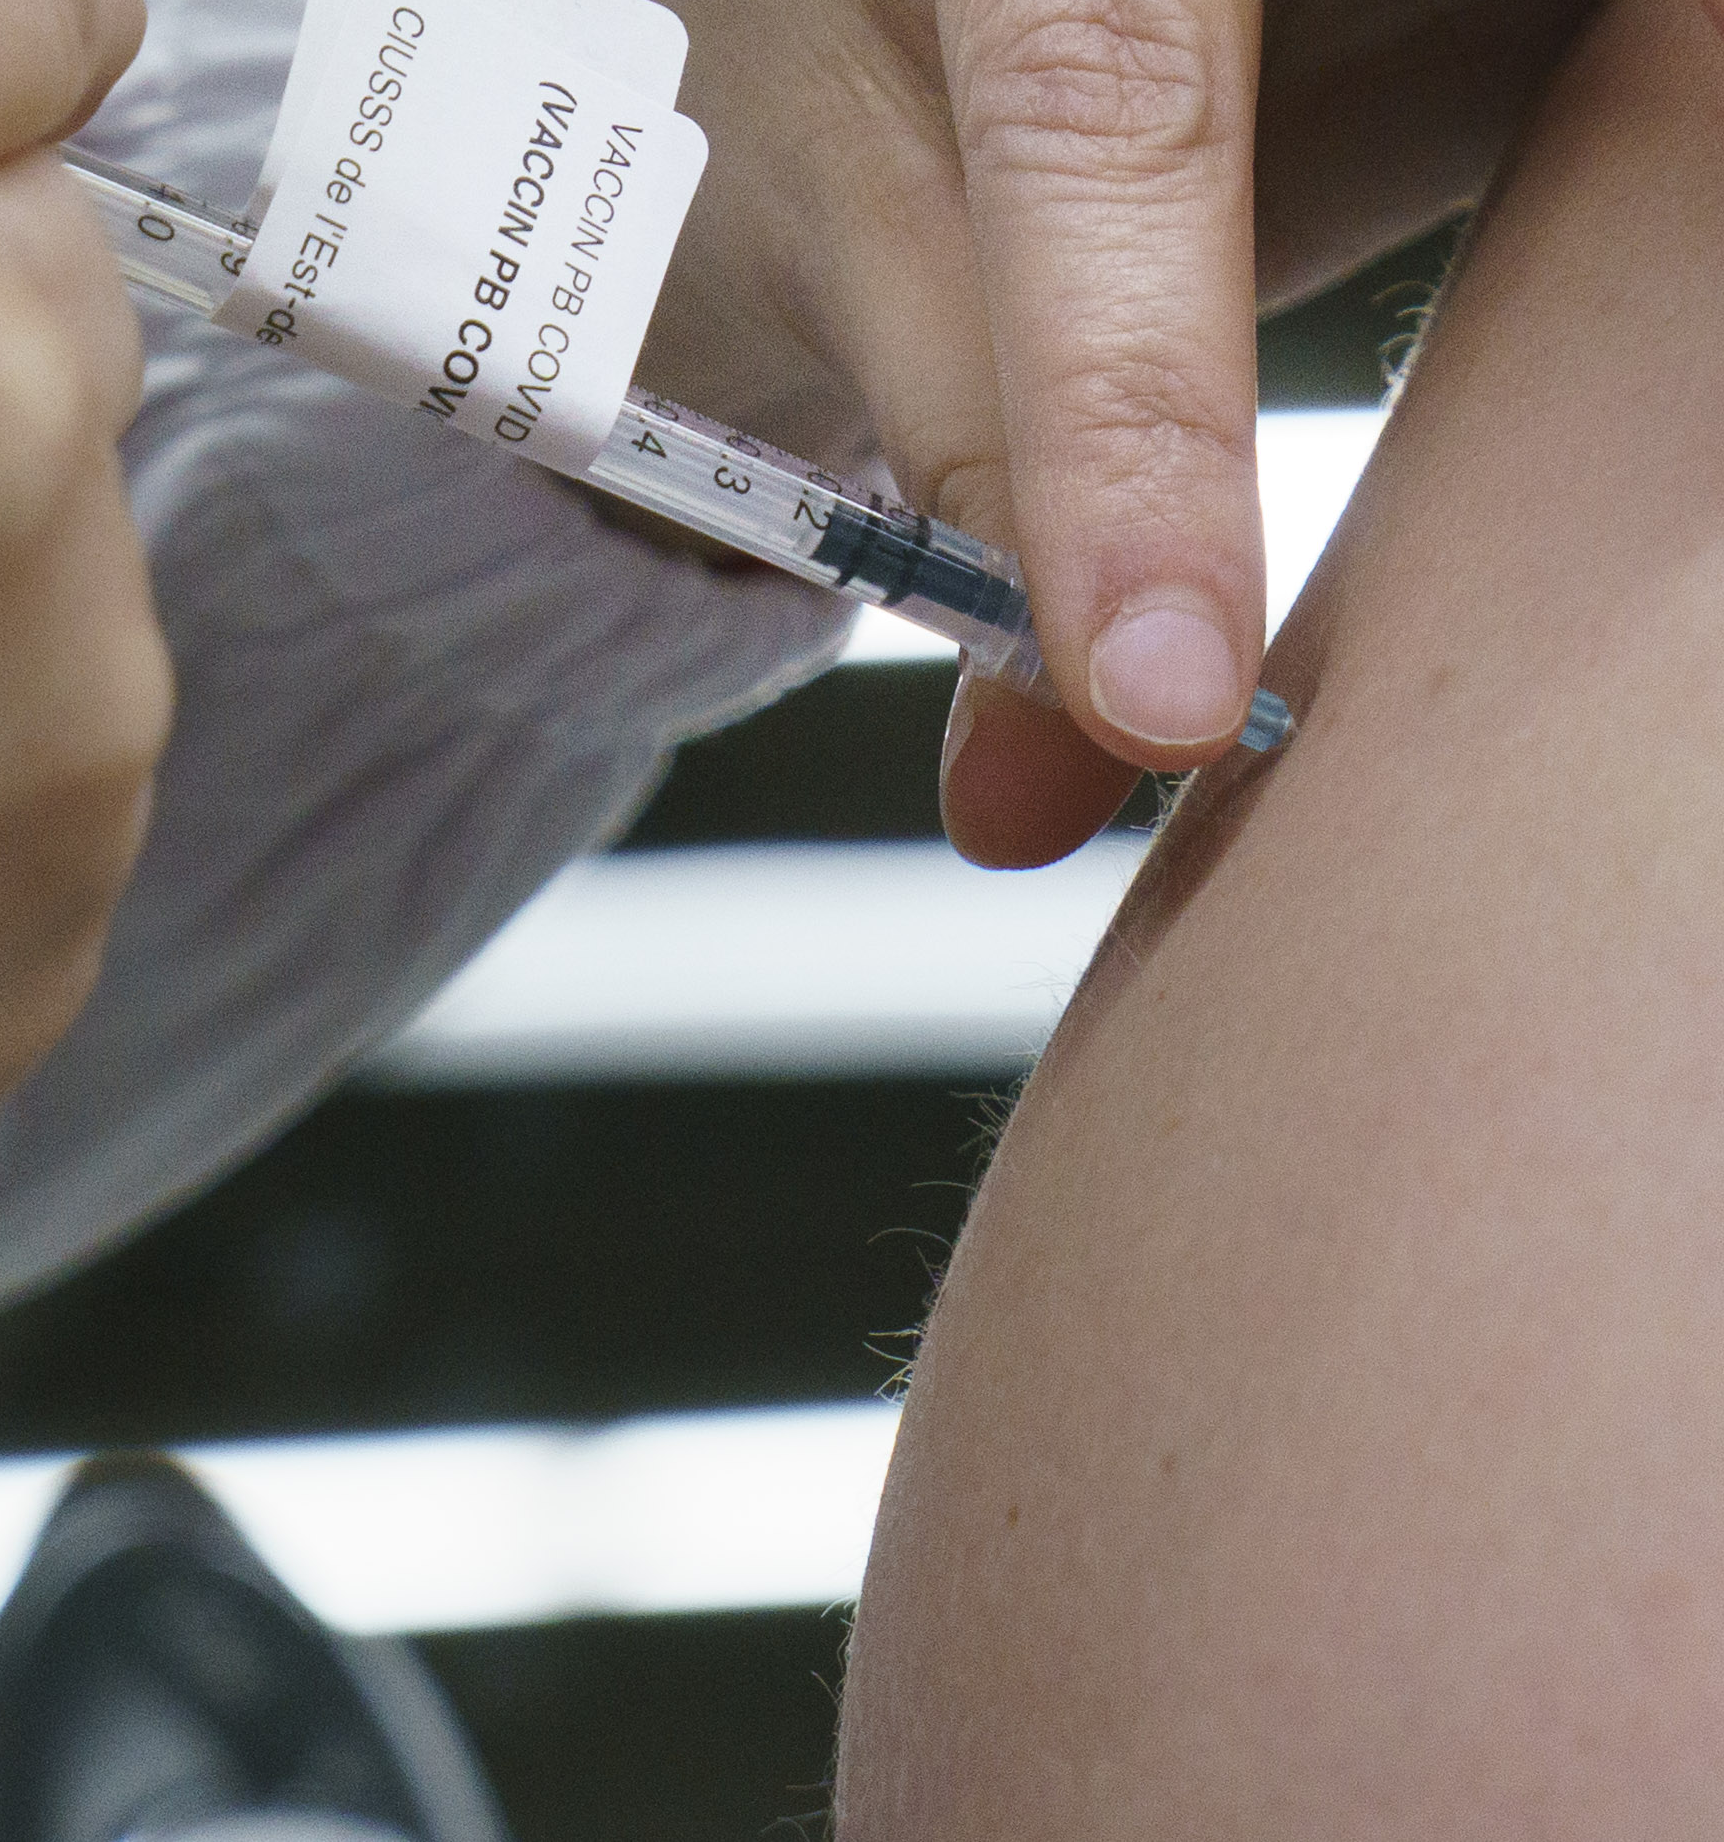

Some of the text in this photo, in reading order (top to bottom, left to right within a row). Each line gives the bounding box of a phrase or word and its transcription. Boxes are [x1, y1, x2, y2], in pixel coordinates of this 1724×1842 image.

[326, 157, 367, 205] de
[349, 6, 425, 152] CIUSSS
[418, 81, 578, 421] (VACCIN PB COVI
[493, 124, 644, 442] VACCIN PB COVID
